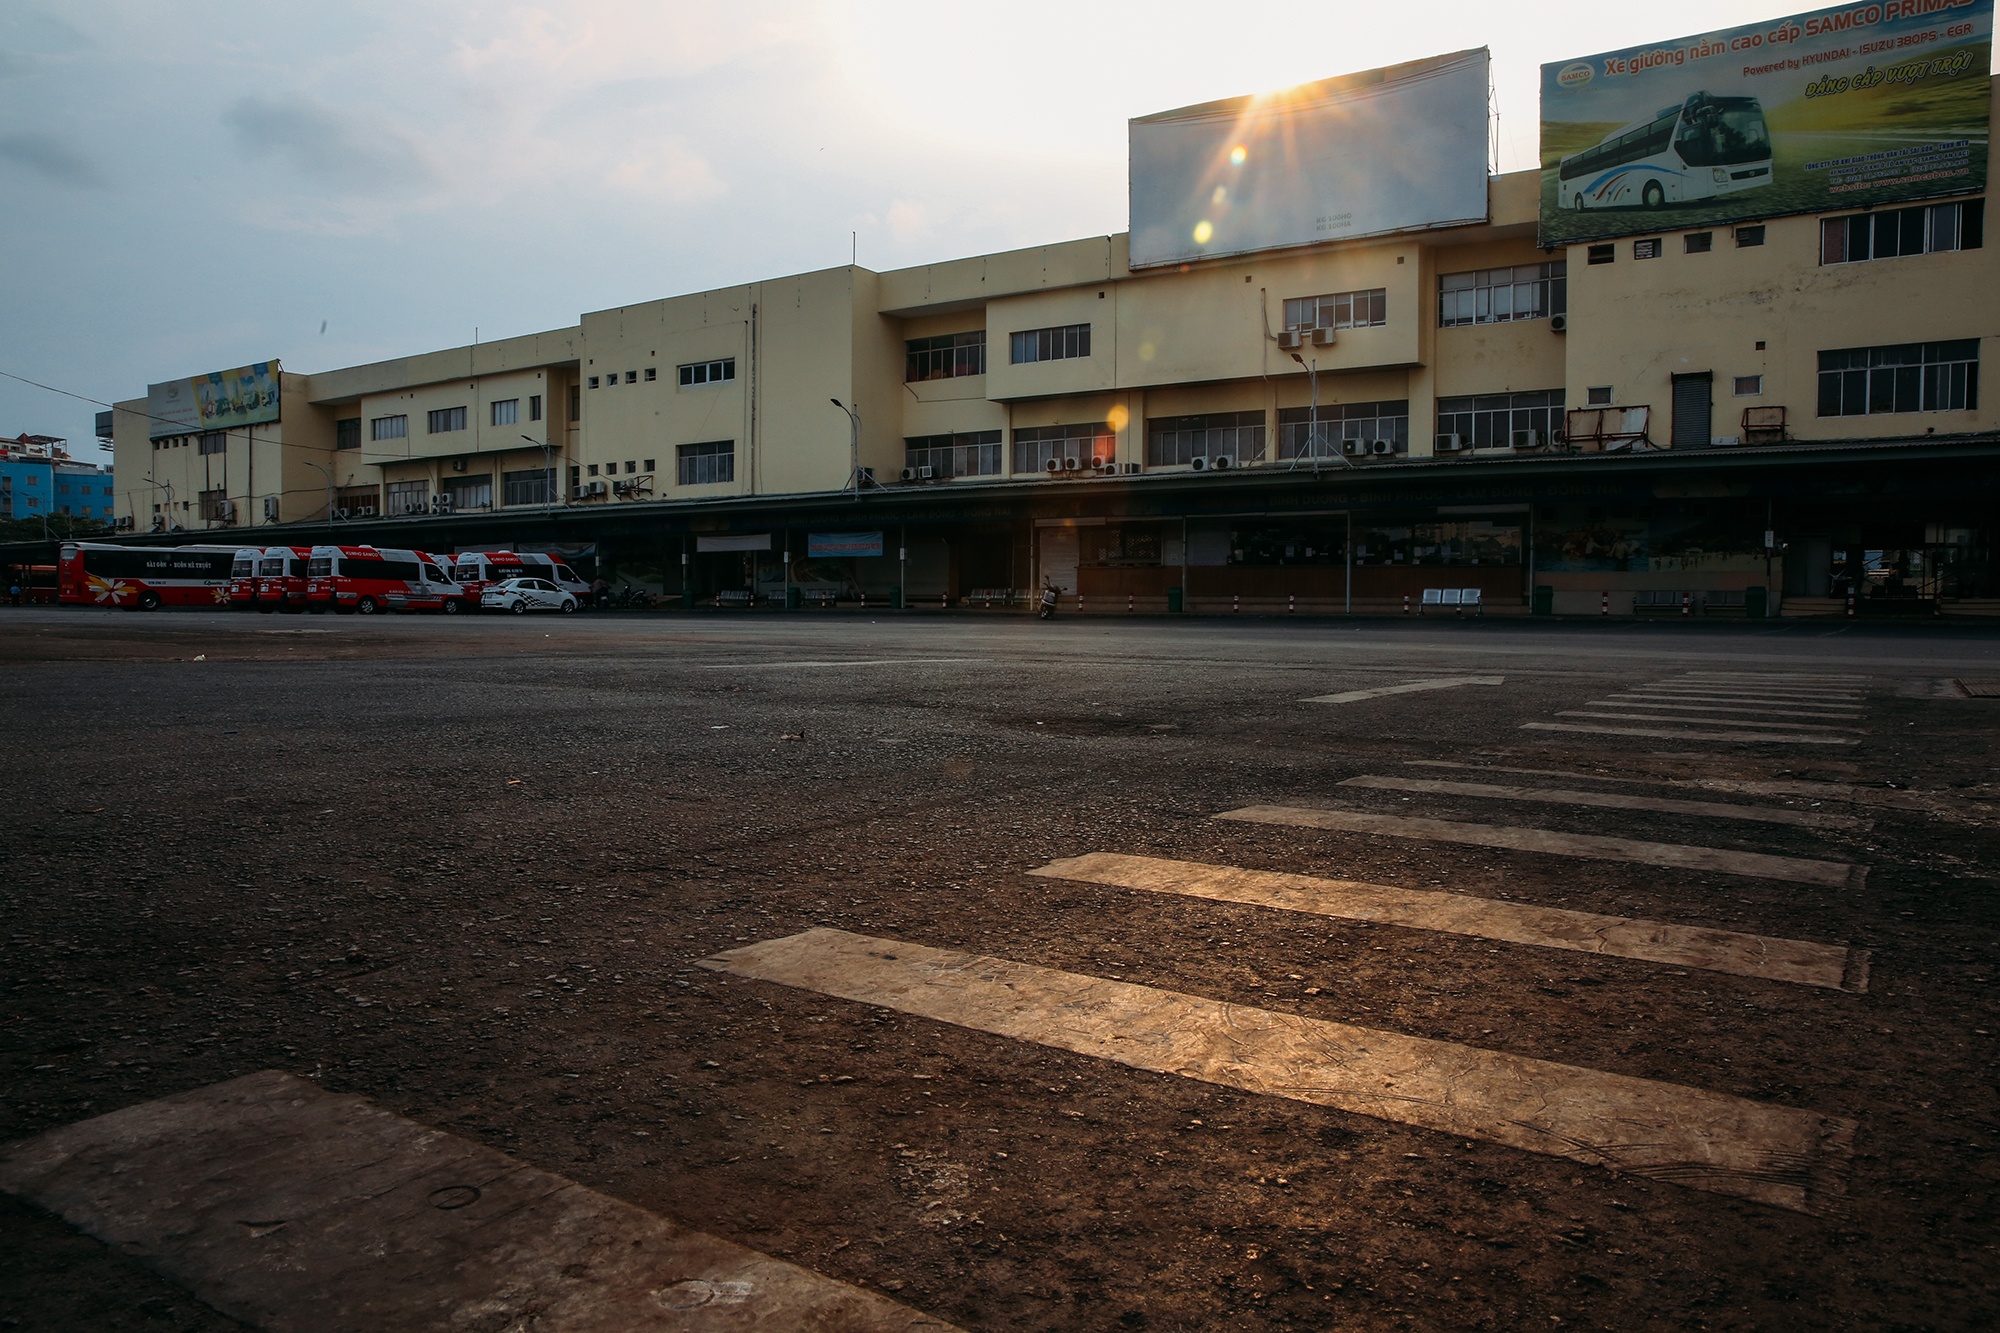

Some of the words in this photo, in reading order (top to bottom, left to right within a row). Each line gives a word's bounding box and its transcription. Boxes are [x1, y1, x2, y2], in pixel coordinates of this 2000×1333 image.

[1605, 59, 1625, 75] Xe
[1630, 49, 1684, 74] giường
[1690, 39, 1725, 59] nằm
[1731, 35, 1762, 51] cao
[1768, 21, 1800, 43] cấp
[1806, 6, 1880, 36] SAMCO
[1744, 60, 1784, 76] Powered
[1788, 59, 1799, 69] by
[1802, 48, 1849, 65] HYUNDAI
[1859, 40, 1894, 54] ISUZU
[1897, 30, 1937, 47] 380PS
[1947, 23, 1972, 36] EGR
[1561, 71, 1590, 81] SAMCO
